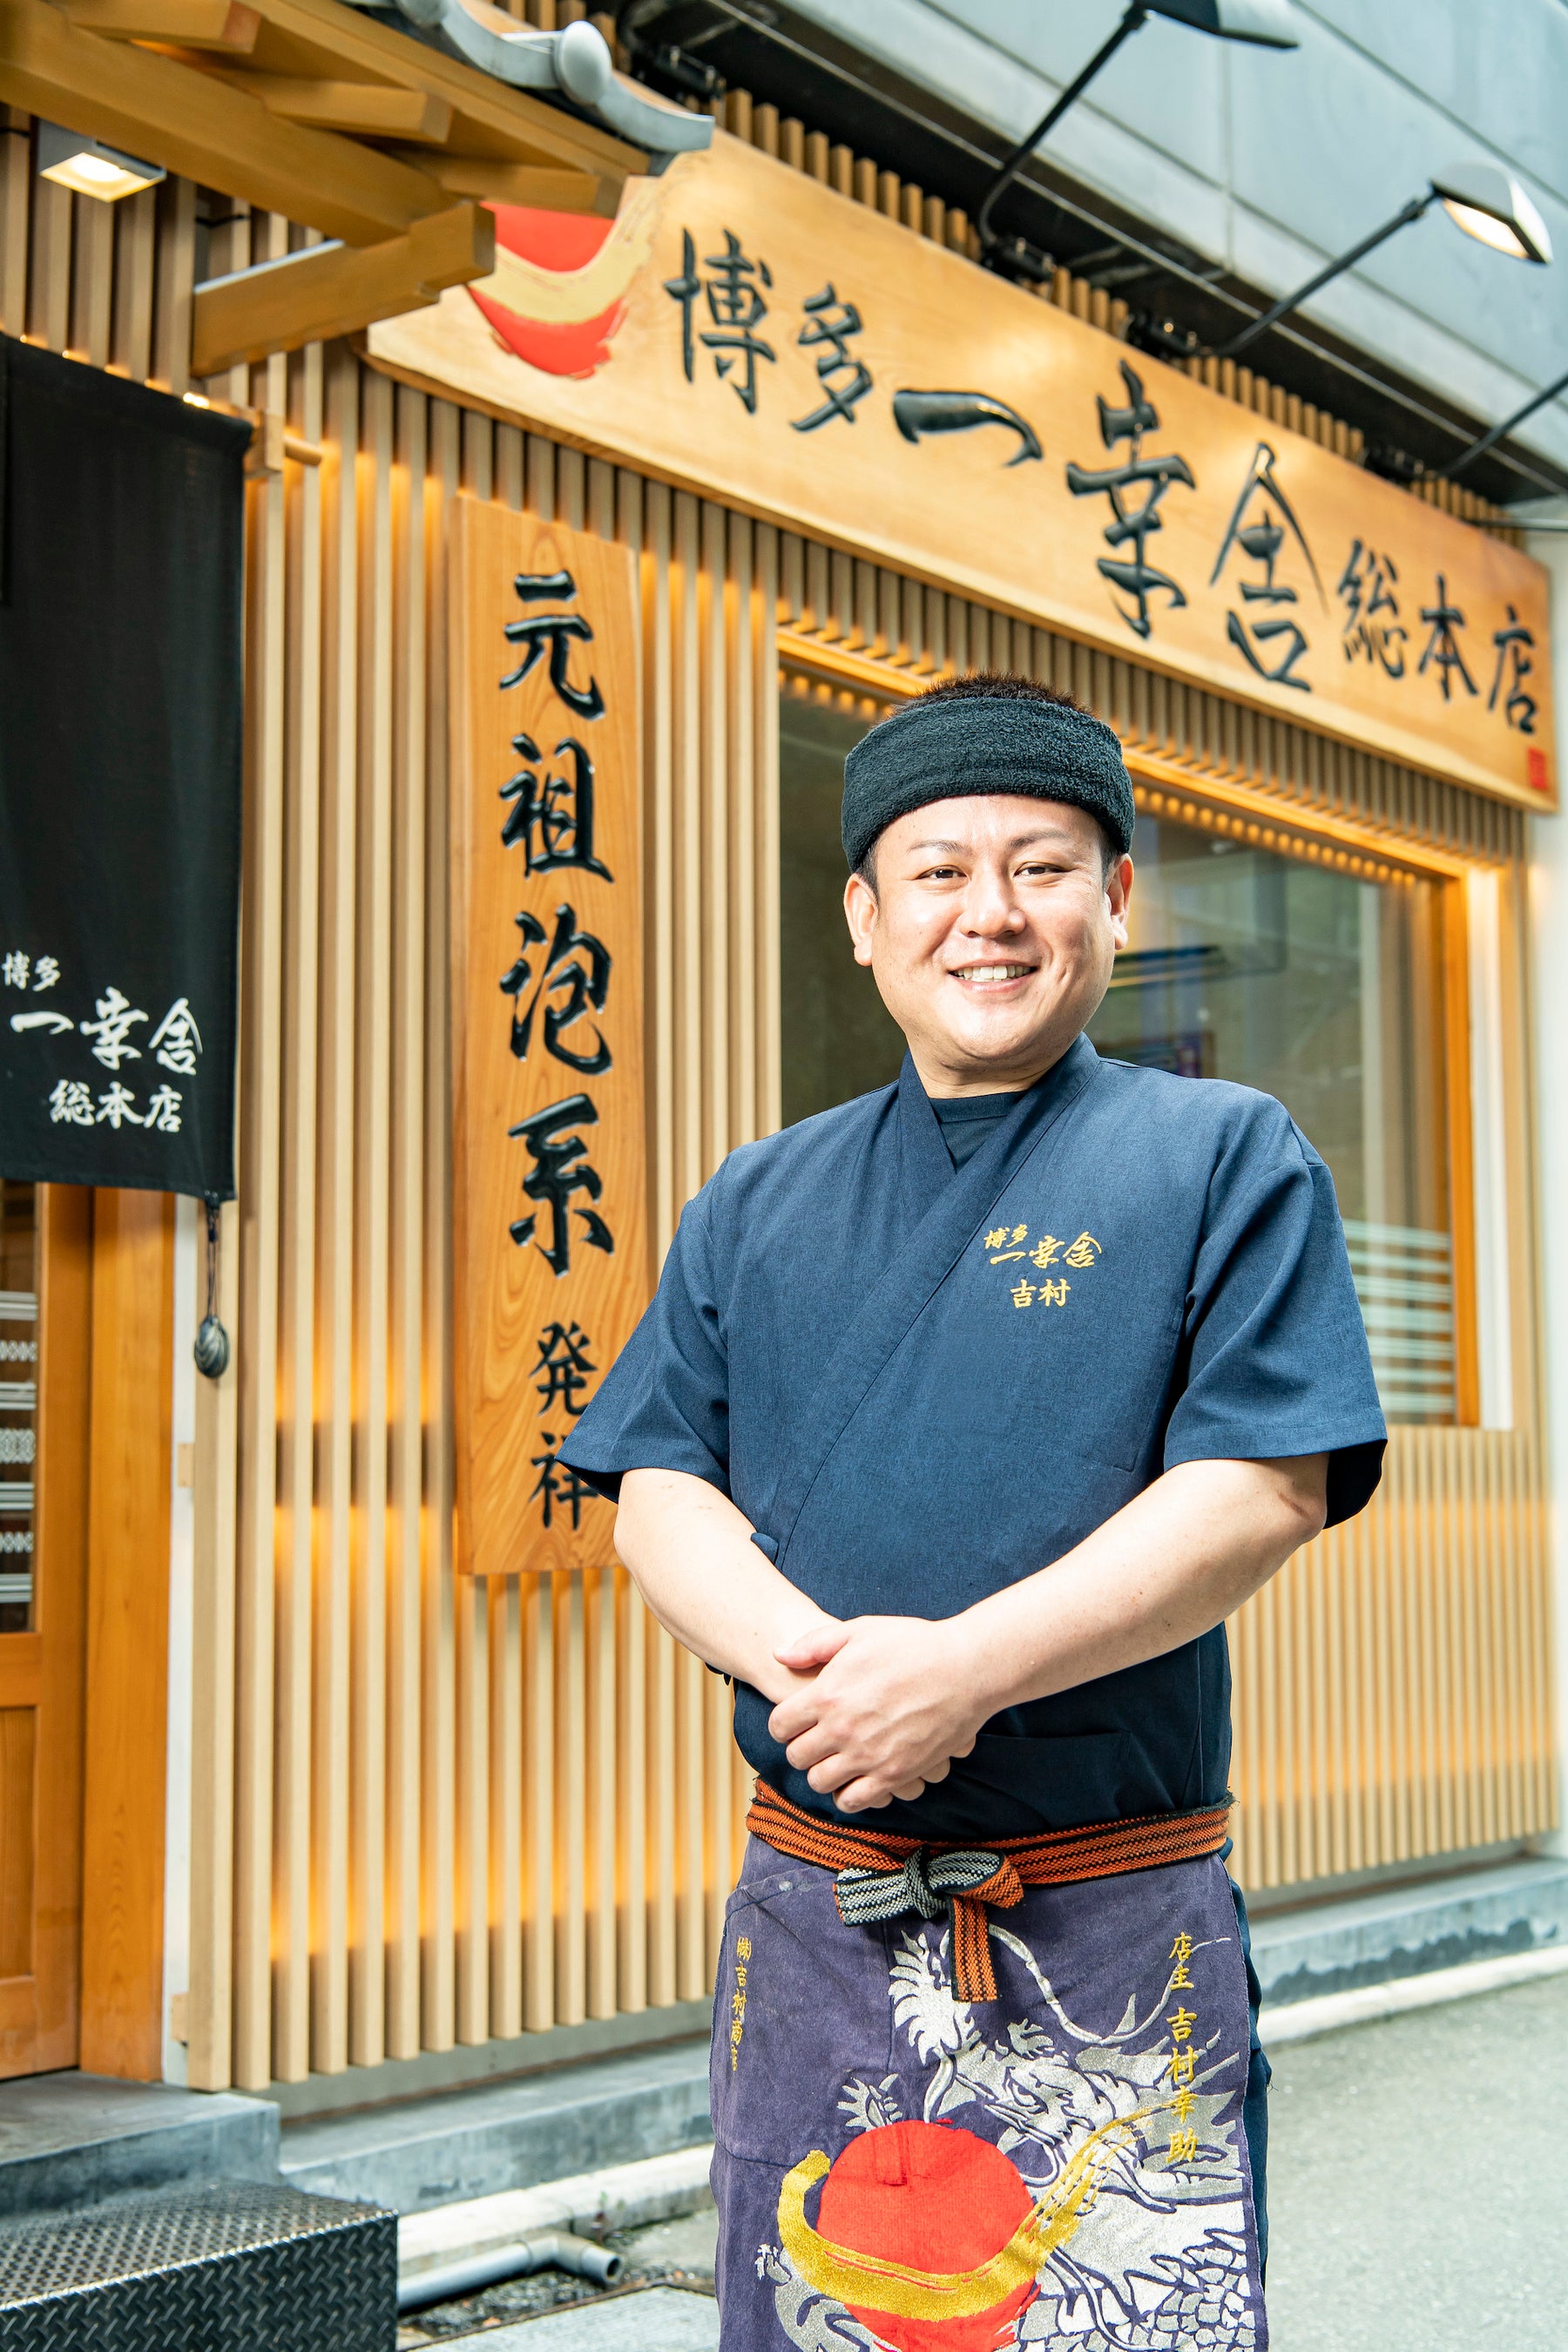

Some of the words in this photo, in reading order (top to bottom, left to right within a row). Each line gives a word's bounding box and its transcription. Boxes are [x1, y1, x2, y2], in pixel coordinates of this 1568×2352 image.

[1, 950, 61, 992] 博多
[10, 985, 203, 1076] 一幸舎
[49, 1078, 183, 1132] 総本店
[983, 1223, 1028, 1249] 博多
[1010, 1278, 1071, 1308] 吉村
